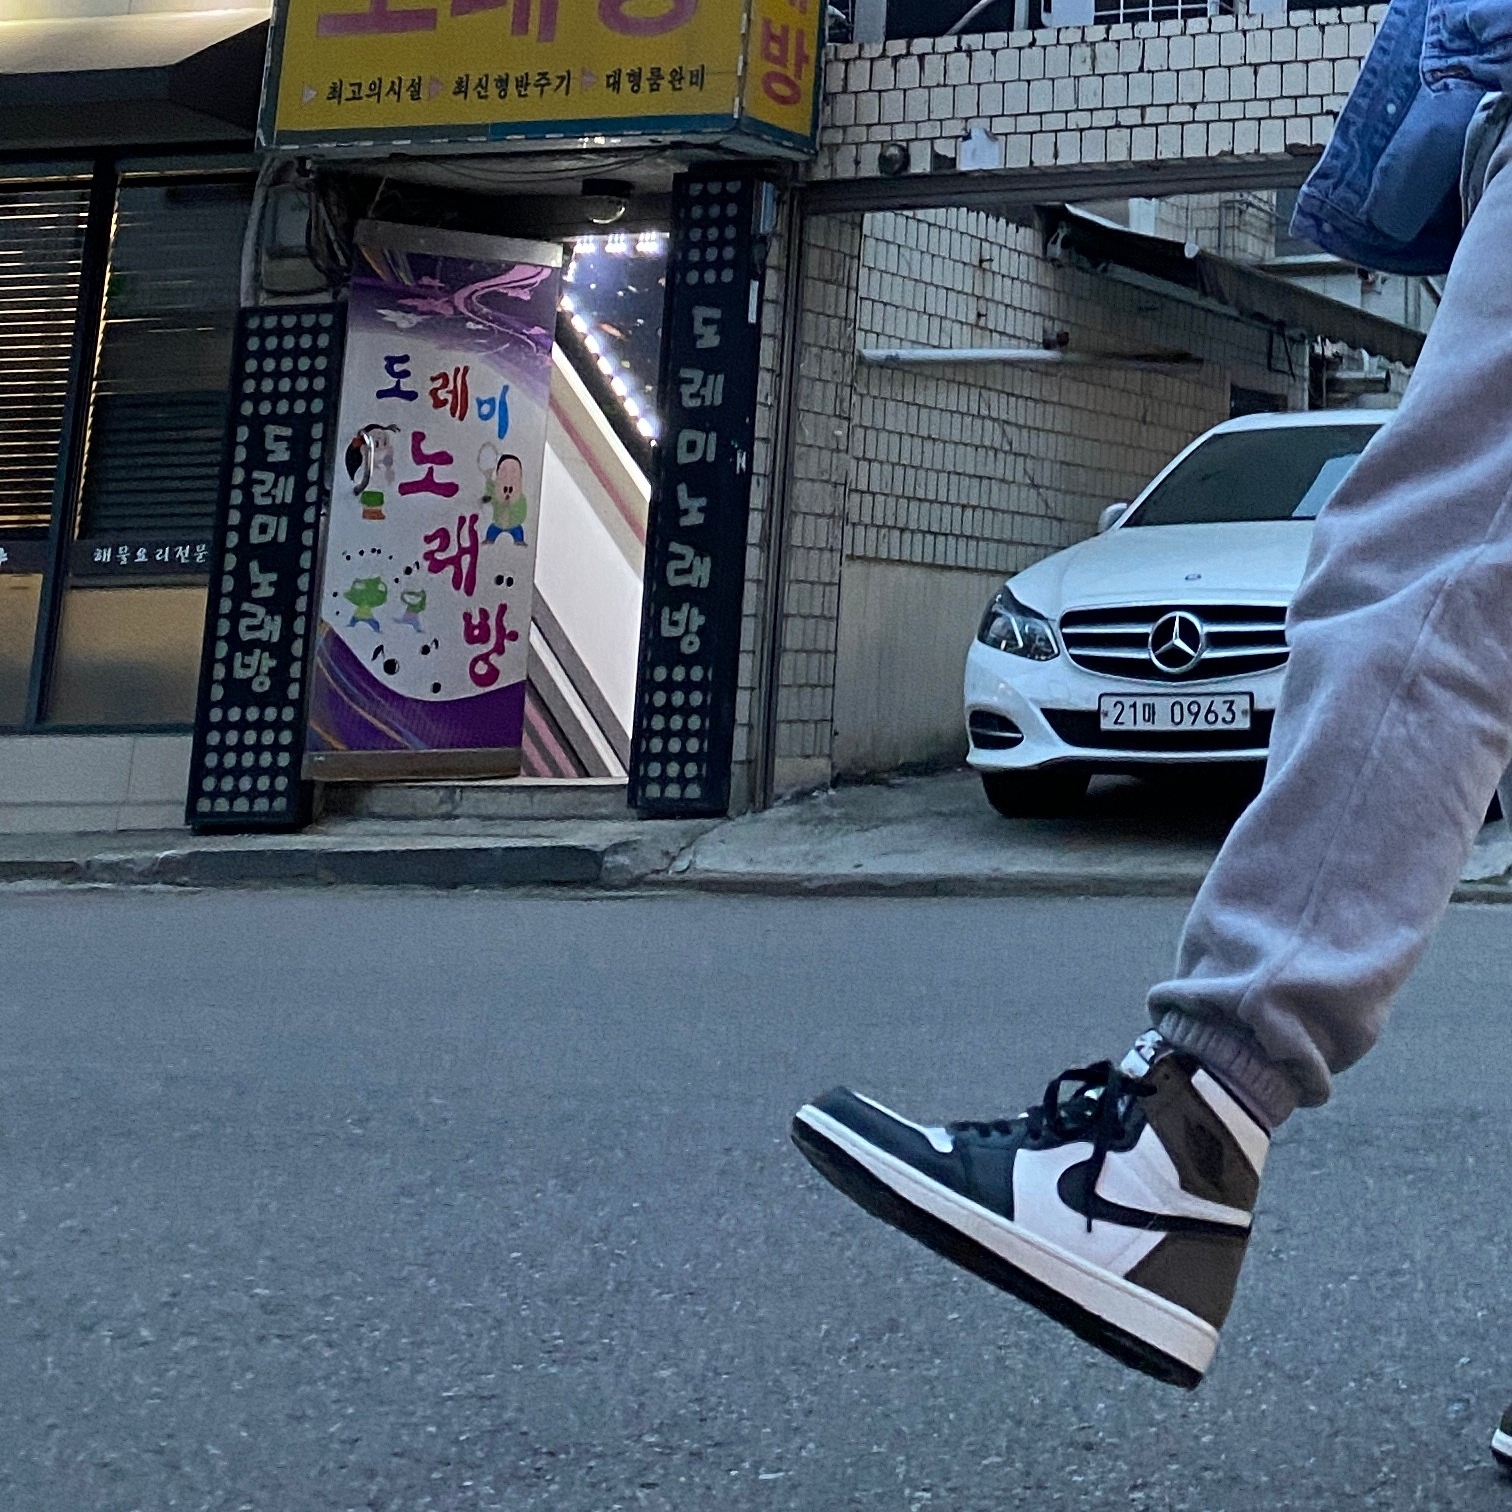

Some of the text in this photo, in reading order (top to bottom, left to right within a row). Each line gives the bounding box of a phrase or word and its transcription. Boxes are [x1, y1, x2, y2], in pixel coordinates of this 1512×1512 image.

[326, 63, 707, 106] 최고의시설 최신형반주기 대형룸완비
[376, 354, 510, 440] 도레미
[93, 543, 209, 565] 해물요리전문
[398, 430, 520, 688] 노래방
[1170, 699, 1236, 726] 0963
